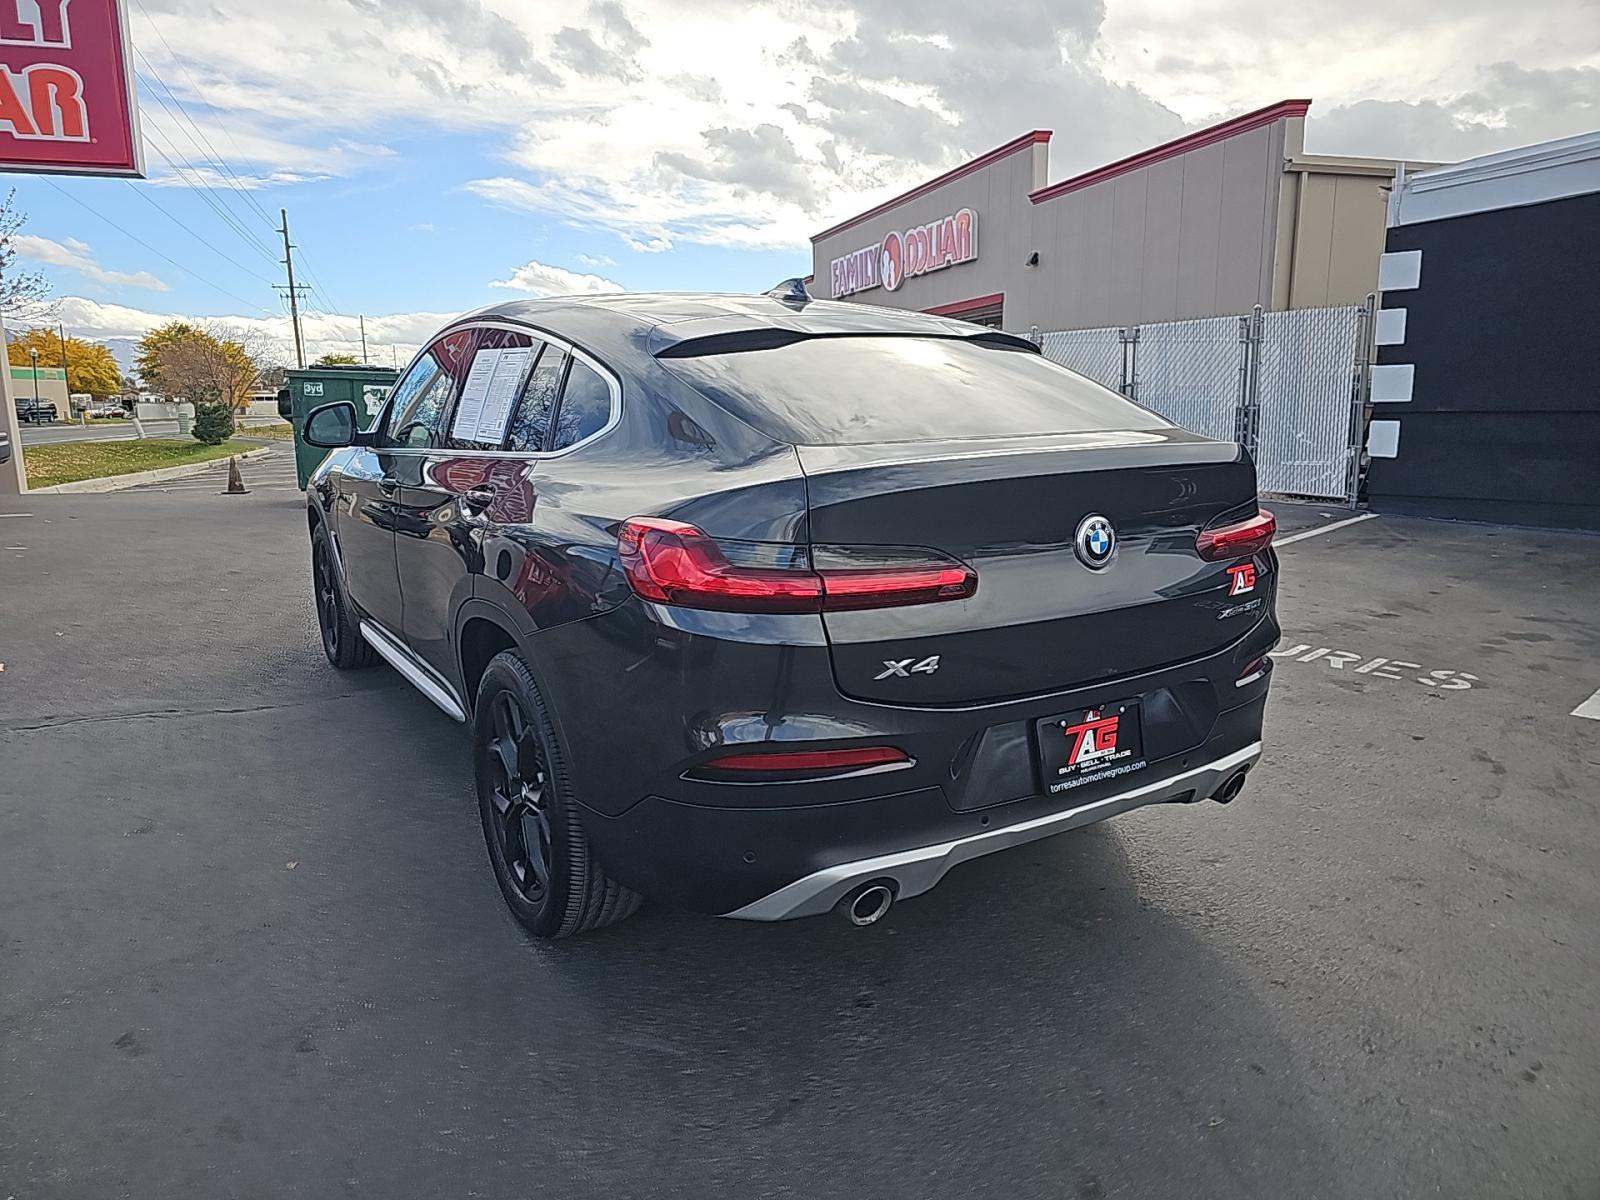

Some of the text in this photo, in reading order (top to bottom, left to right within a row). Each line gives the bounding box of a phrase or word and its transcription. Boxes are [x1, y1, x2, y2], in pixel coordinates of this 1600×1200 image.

[832, 209, 974, 297] FAMILY DOLLAR
[1226, 563, 1256, 596] TAG
[873, 655, 940, 680] X4
[1065, 716, 1119, 765] TAG
[1050, 760, 1147, 793] torresautomotivegroup.com
[1058, 765, 1076, 775] BUY
[1080, 759, 1100, 769] SELL
[1105, 749, 1132, 762] TRADE
